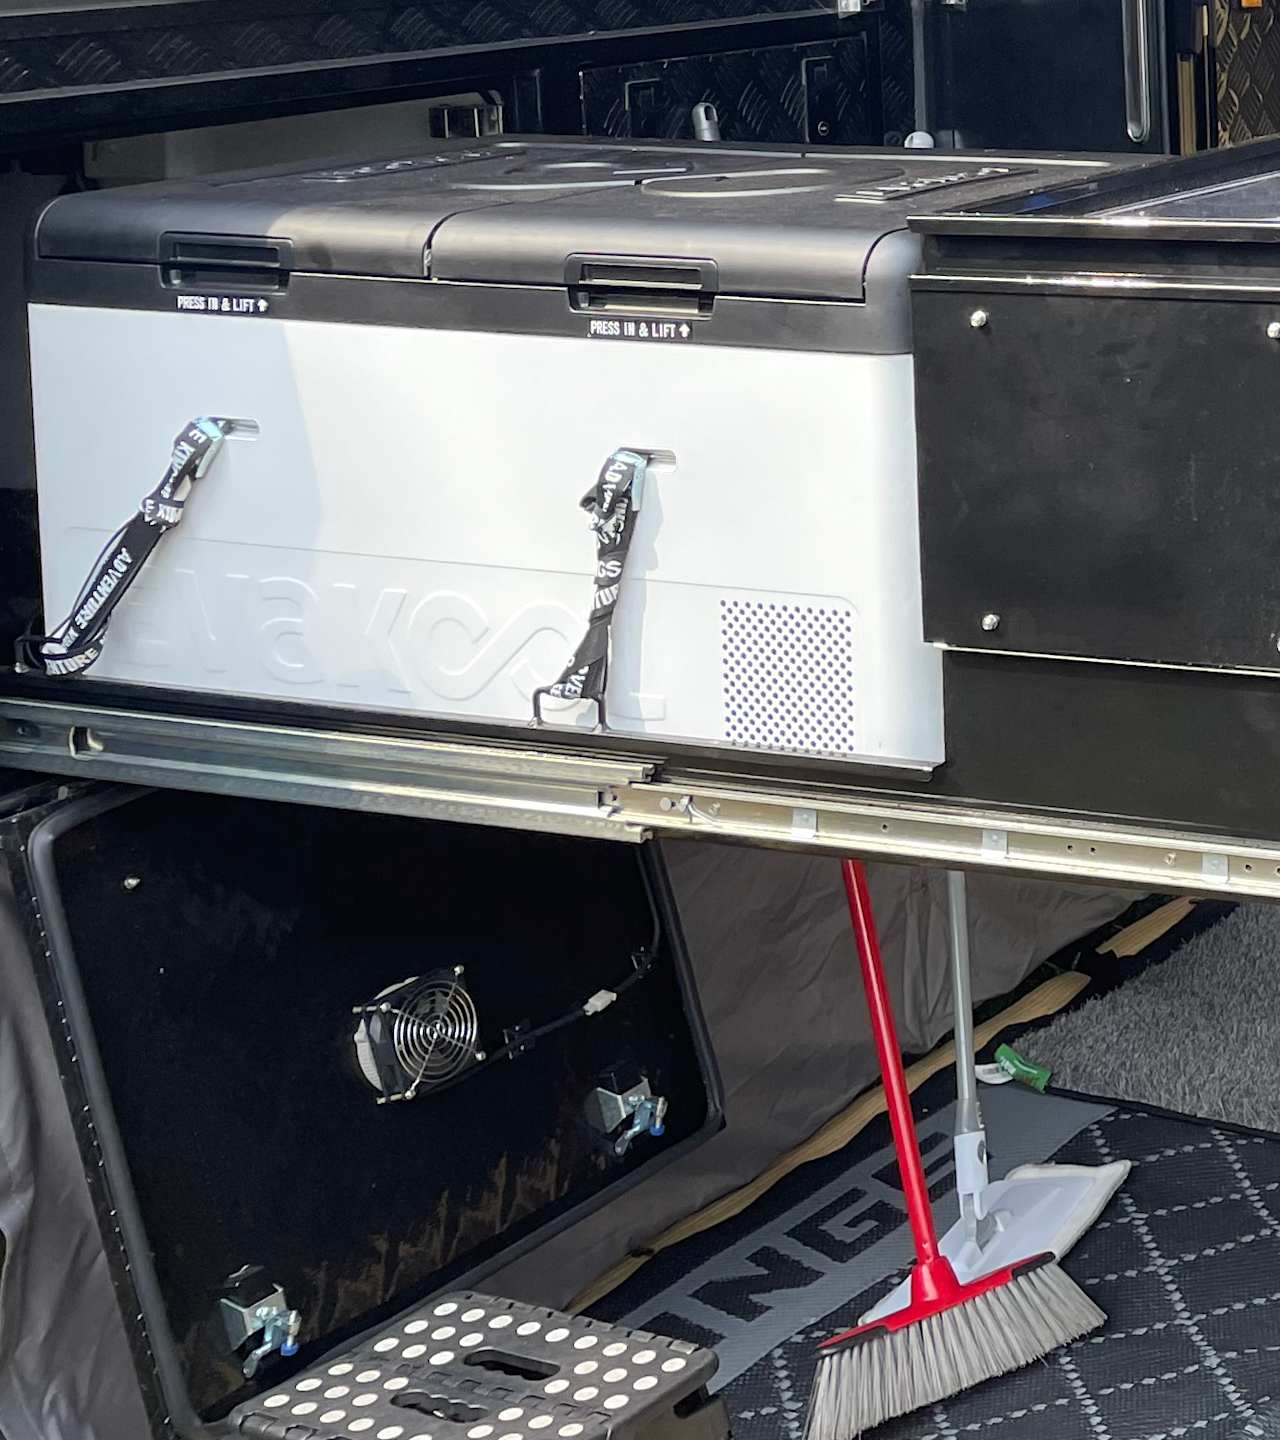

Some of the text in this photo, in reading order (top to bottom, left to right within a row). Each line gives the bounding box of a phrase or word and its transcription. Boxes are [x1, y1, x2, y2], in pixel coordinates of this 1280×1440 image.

[177, 295, 255, 312] PRESS IN & LIFT
[590, 320, 676, 338] PRESS IN & LIFT
[74, 546, 133, 630] ADVENTURE
